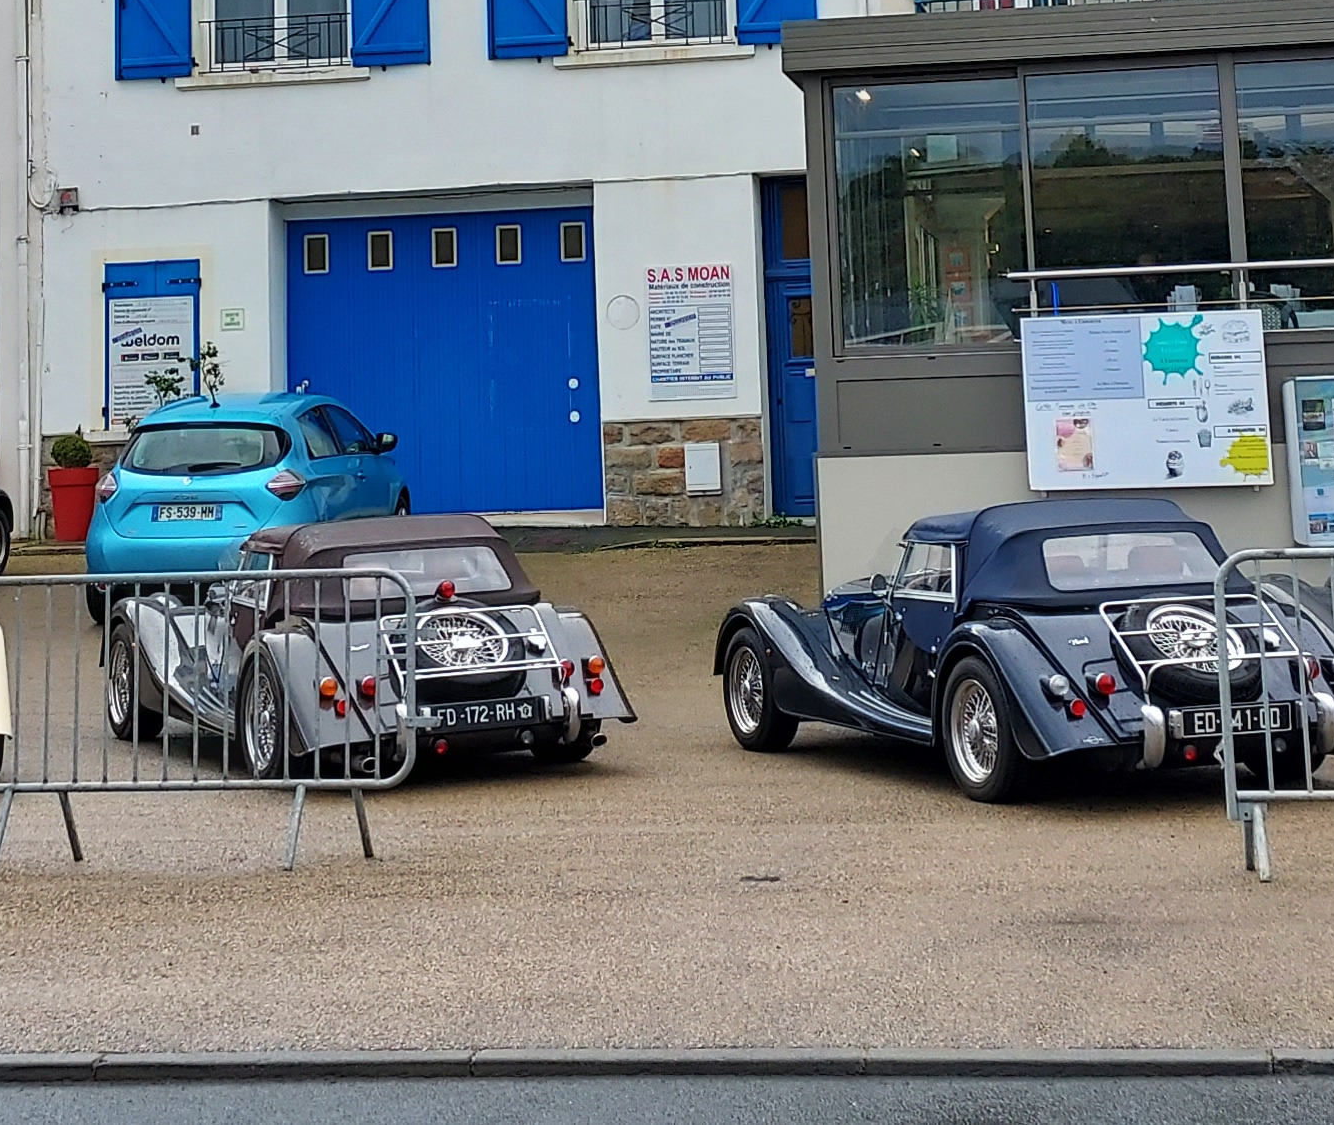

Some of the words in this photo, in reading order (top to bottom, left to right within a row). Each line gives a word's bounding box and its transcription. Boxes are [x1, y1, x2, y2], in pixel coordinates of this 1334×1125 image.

[647, 267, 684, 283] S.A.S
[688, 265, 730, 281] MOAN
[648, 282, 679, 290] Matériaux
[690, 281, 730, 289] construction
[121, 333, 180, 347] weldom
